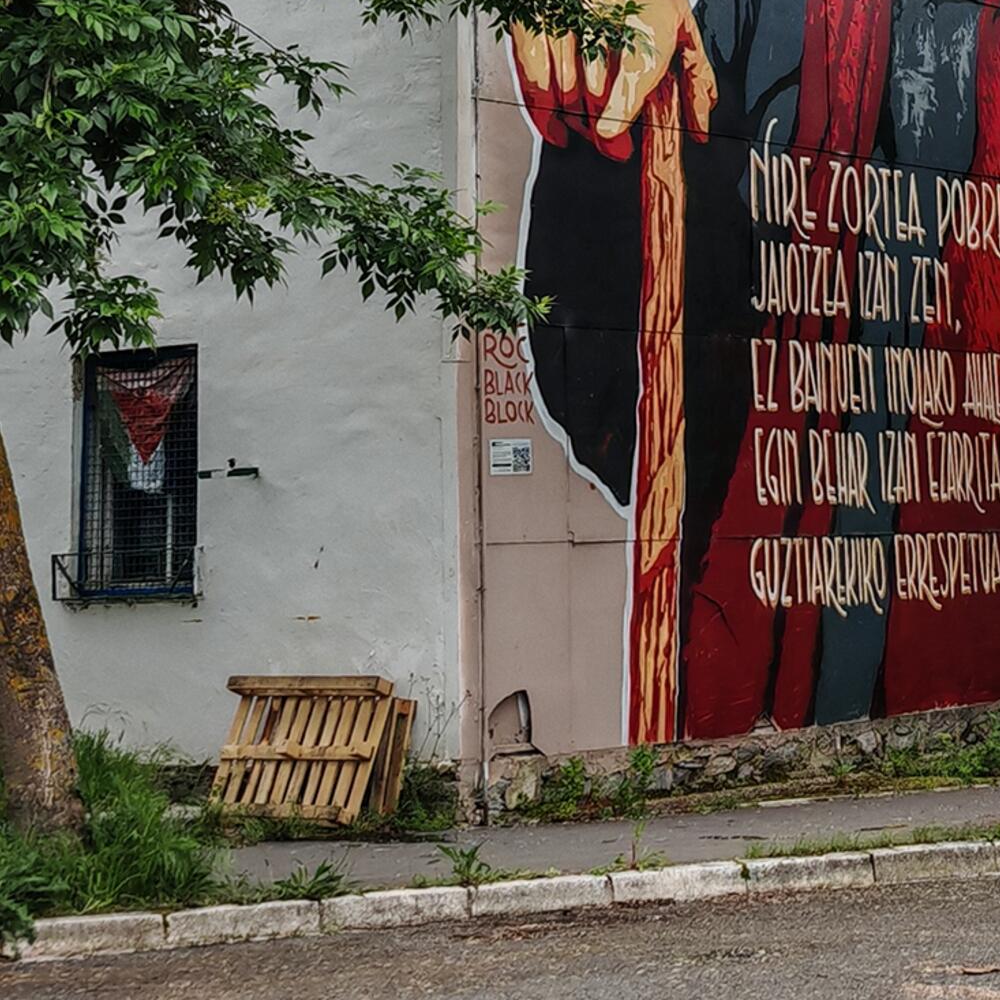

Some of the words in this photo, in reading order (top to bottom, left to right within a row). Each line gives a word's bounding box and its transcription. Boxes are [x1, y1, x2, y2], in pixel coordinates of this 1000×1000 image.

[750, 117, 817, 240] NIRE
[827, 160, 927, 251] ZORTEA
[750, 240, 851, 319] JAIOTZEA
[857, 250, 900, 322] IZAN
[483, 332, 530, 369] ROC
[484, 368, 534, 396] BLACK
[750, 337, 778, 412] EZ
[788, 339, 877, 416] BAINUEN
[884, 345, 956, 429] INOLAKO
[484, 397, 535, 424] BLOCK
[754, 427, 802, 506] EGIN
[808, 427, 876, 514] BEHAR
[878, 430, 921, 503] IZAN
[749, 536, 888, 618] GUZTIAREKIKO
